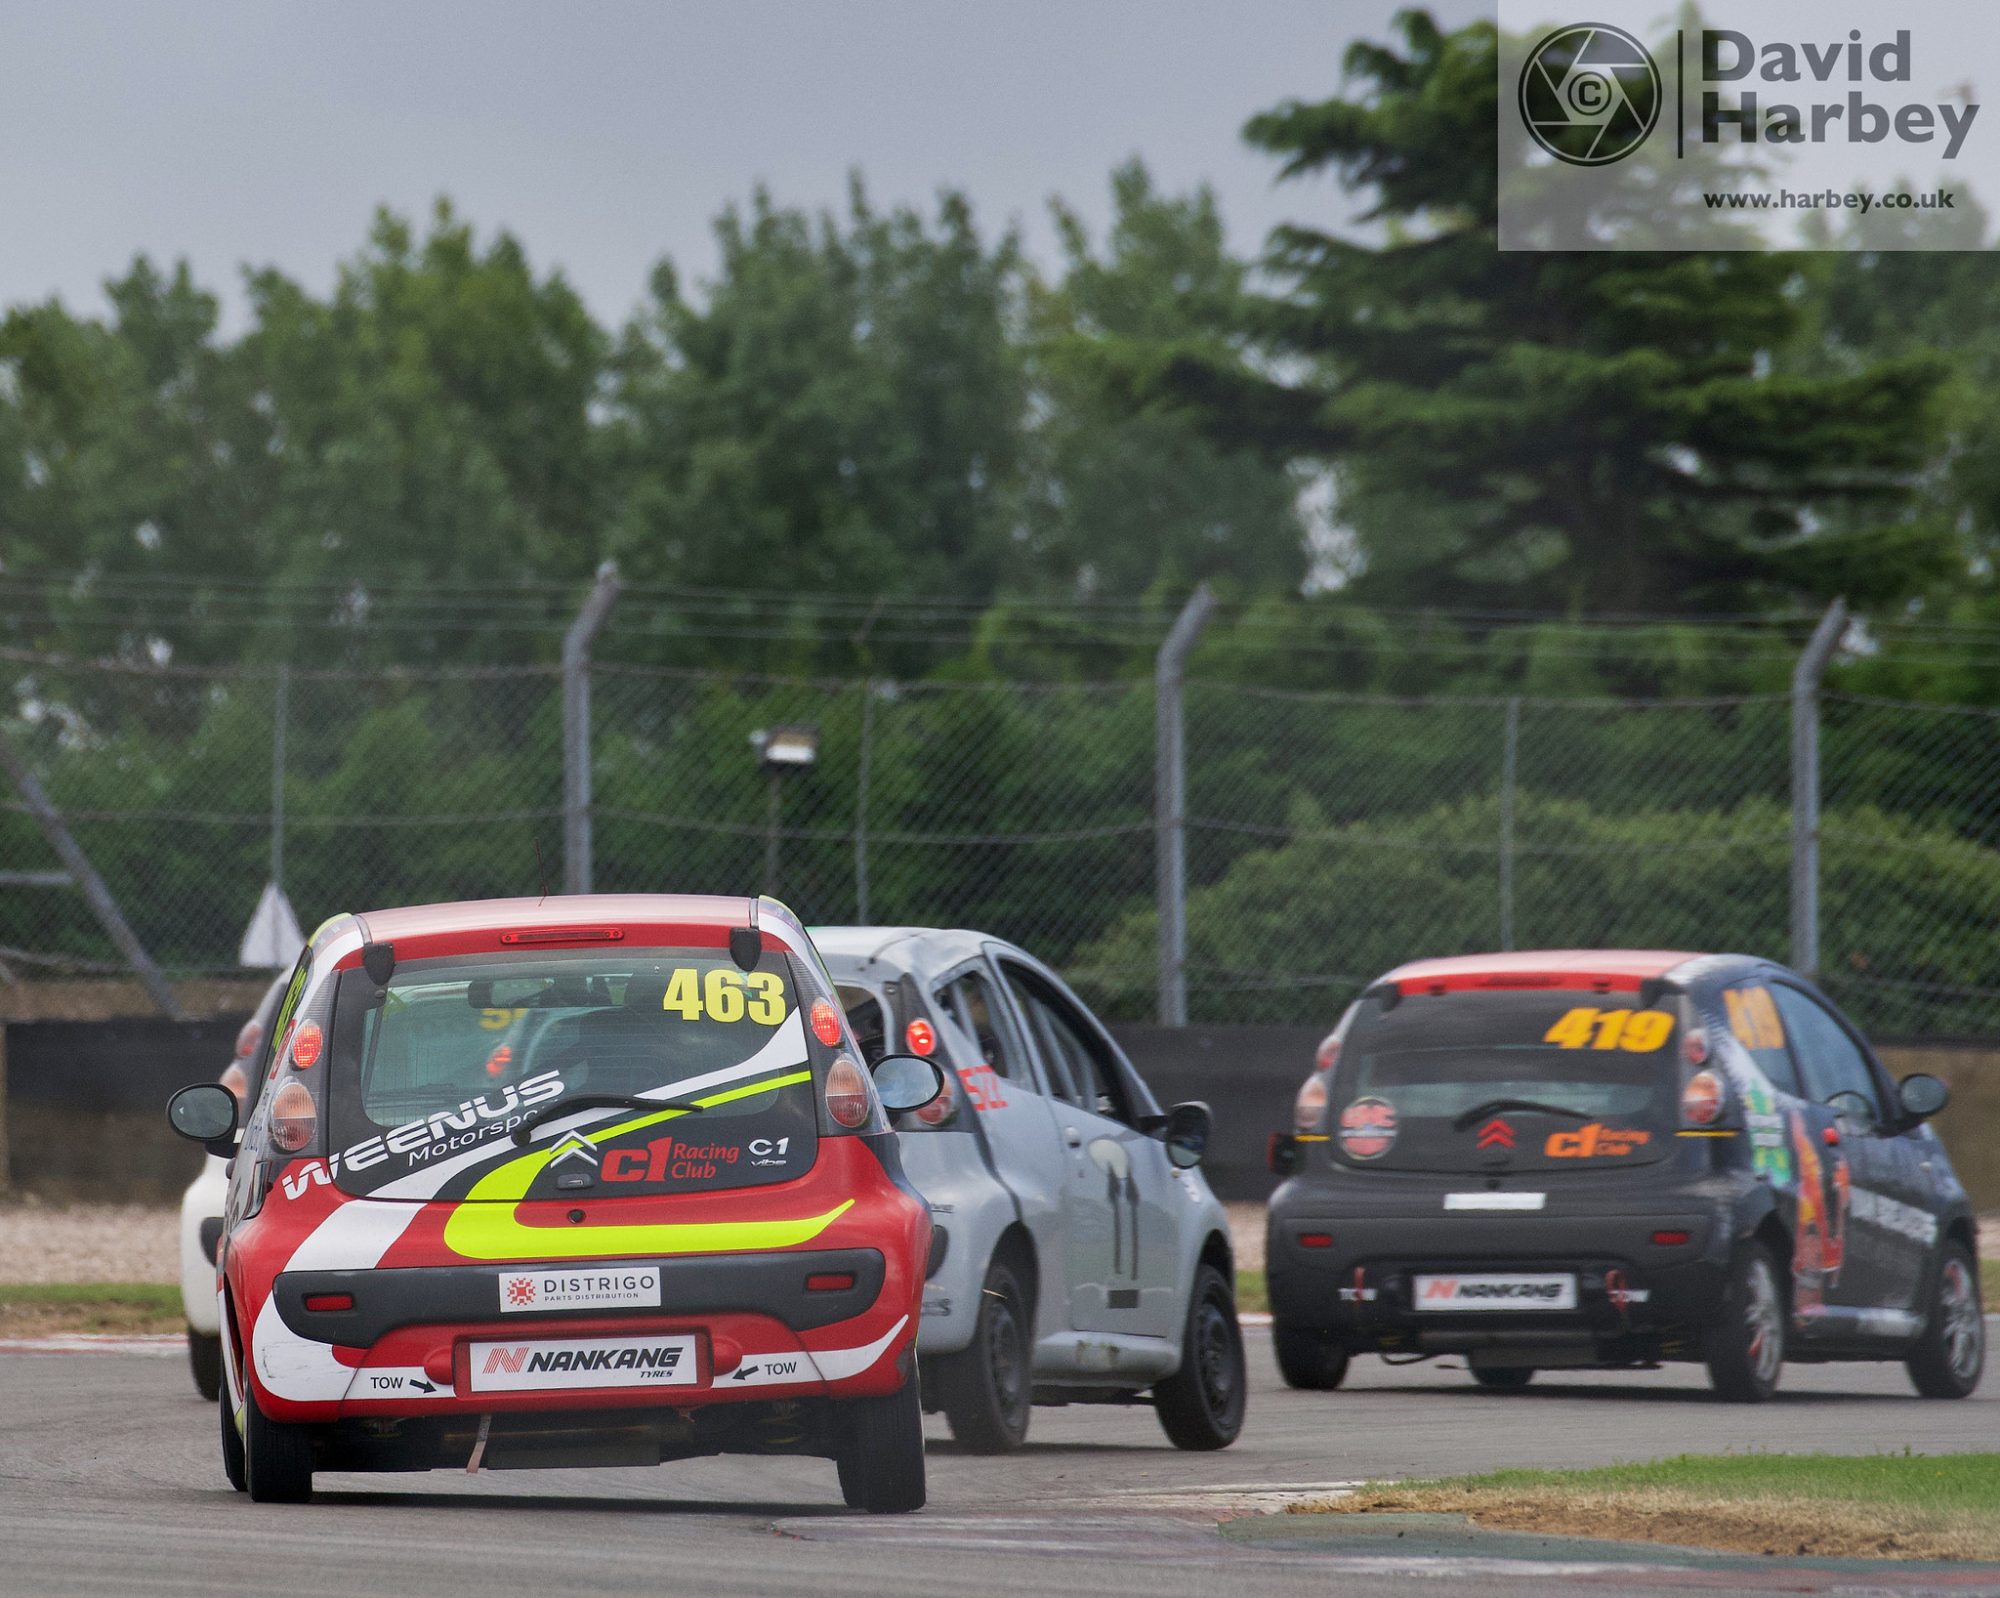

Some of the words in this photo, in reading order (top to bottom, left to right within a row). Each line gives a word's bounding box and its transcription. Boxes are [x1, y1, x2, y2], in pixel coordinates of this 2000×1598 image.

[663, 968, 787, 1026] 463
[1543, 1007, 1676, 1053] 419
[281, 1069, 565, 1201] WEENUS
[673, 1142, 740, 1164] Racing
[748, 1136, 790, 1156] C1
[671, 1160, 717, 1180] Club
[544, 1275, 655, 1293] DISTRIGO
[544, 1294, 573, 1302] PARTS
[575, 1292, 640, 1301] DISTRIBUTION
[527, 1346, 684, 1374] NANKANG
[765, 1361, 797, 1377] TOW
[370, 1376, 404, 1390] TOW
[640, 1369, 674, 1379] TYRES
